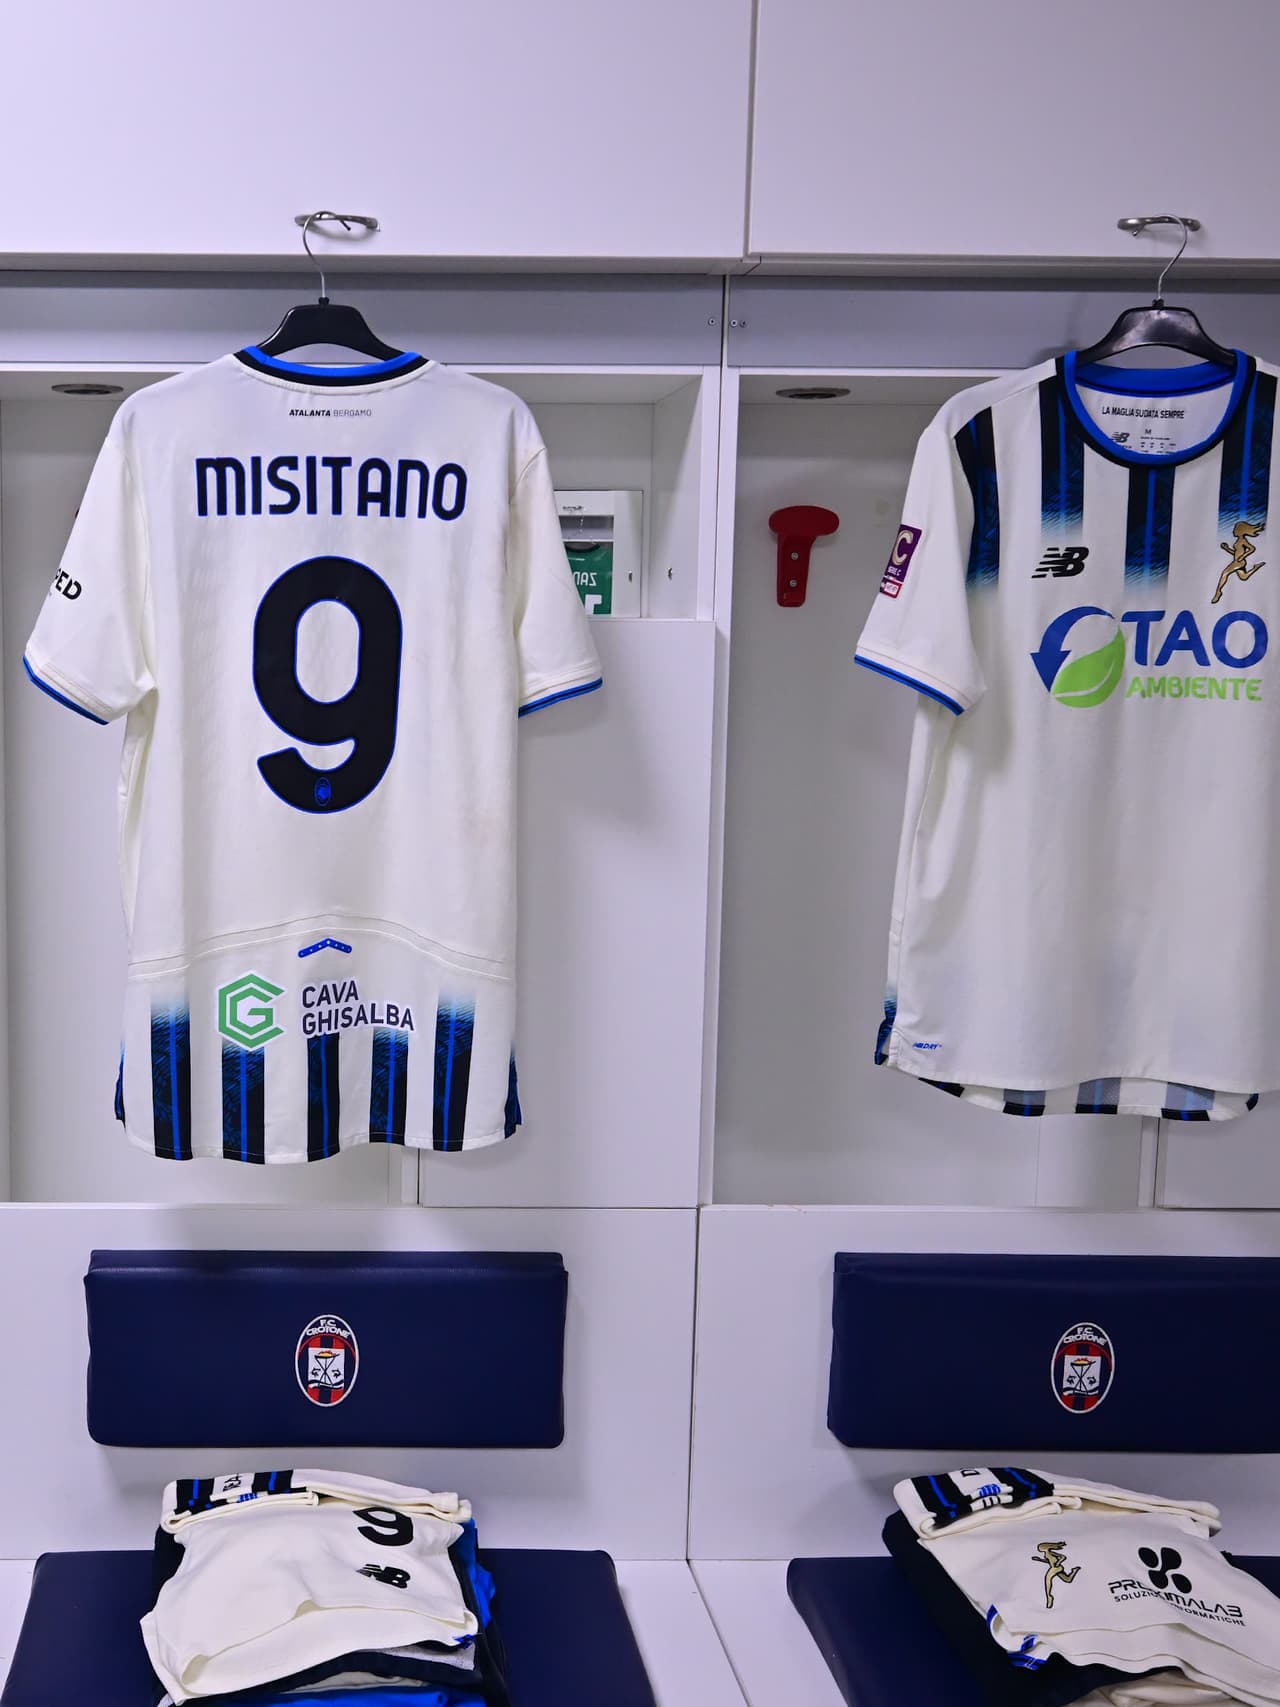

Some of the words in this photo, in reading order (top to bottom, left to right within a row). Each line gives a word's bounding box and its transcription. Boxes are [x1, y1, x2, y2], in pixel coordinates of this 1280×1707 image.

[289, 409, 331, 417] ATALANTA
[333, 409, 372, 417] BERGAMO
[1102, 406, 1110, 415] LA
[1112, 407, 1134, 417] MAGLIA
[1135, 409, 1159, 418] SUDATA
[1160, 410, 1185, 419] SEMPRE
[195, 456, 468, 521] MISITANO
[55, 568, 82, 600] ED
[1121, 610, 1268, 669] TAO
[252, 555, 403, 814] 9
[1126, 675, 1263, 702] AMBIENTE
[302, 980, 359, 1008] CAVA
[302, 1003, 414, 1035] GHISALBA
[306, 1326, 351, 1338] CROTONE
[1063, 1334, 1107, 1346] CROTONE
[352, 1506, 414, 1547] 9
